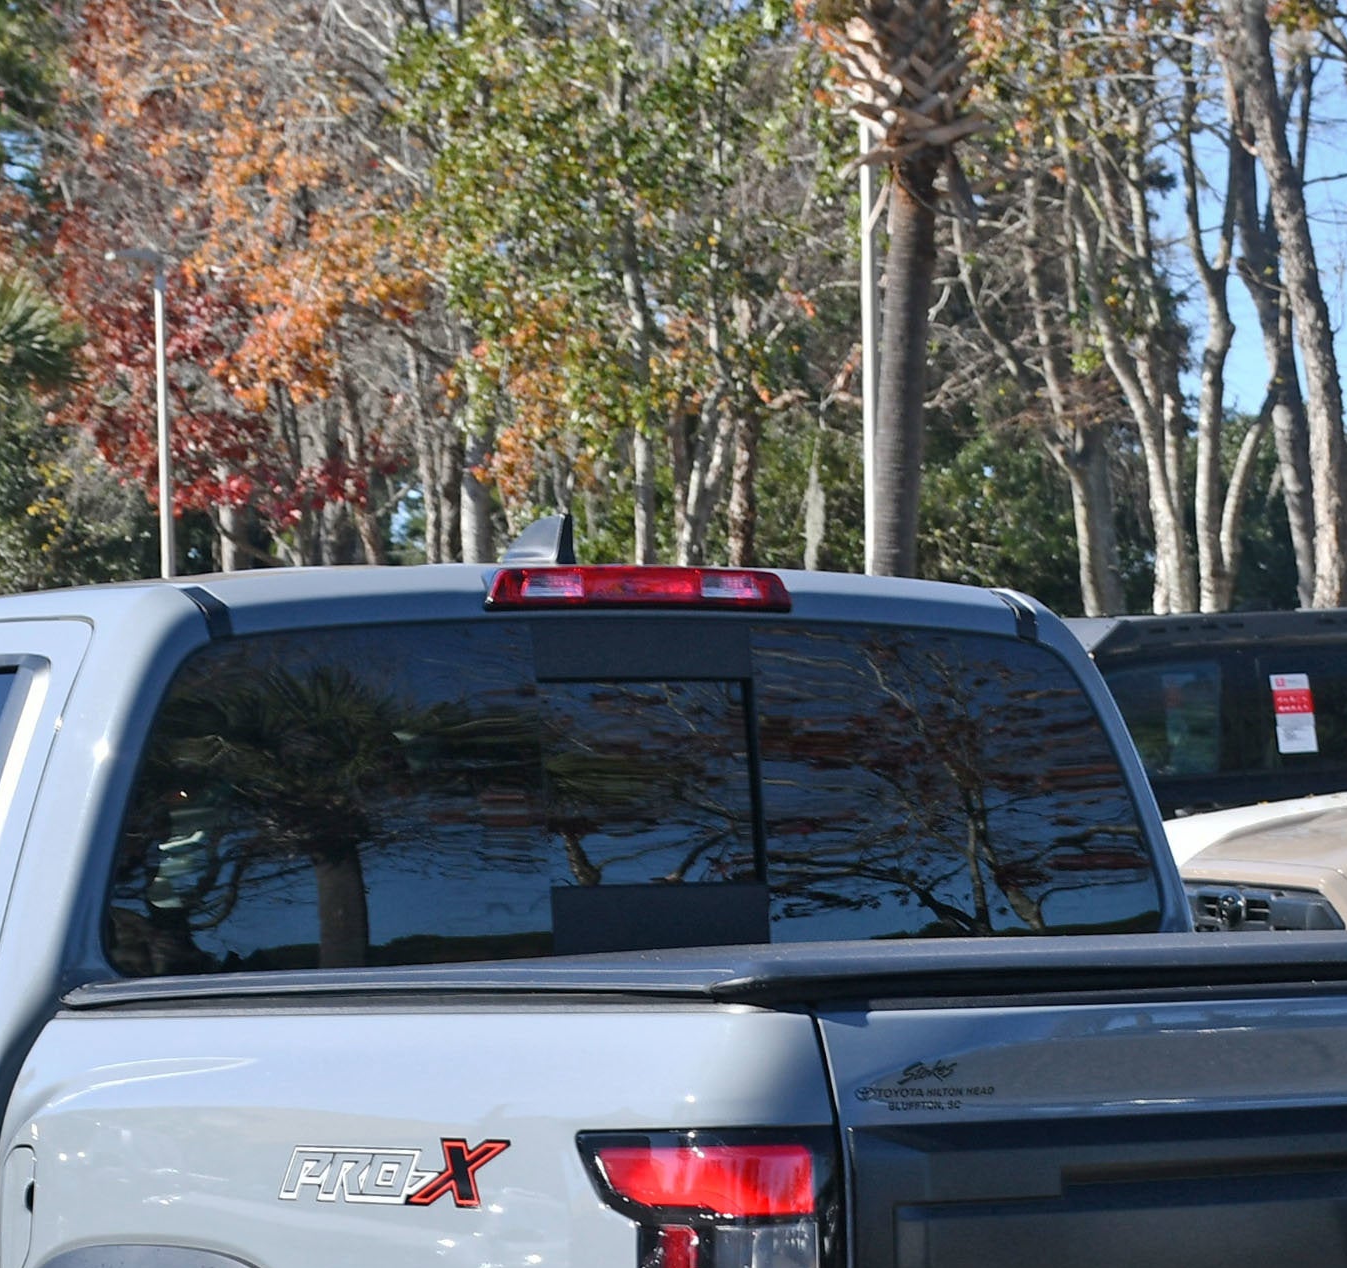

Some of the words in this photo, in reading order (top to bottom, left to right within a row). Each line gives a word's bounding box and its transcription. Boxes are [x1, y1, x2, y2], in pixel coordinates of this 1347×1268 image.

[875, 1087, 924, 1099] TOYOTA
[926, 1086, 963, 1098] HILTON
[967, 1085, 995, 1096] HEAD
[888, 1101, 945, 1112] BLUFFTON,
[948, 1100, 962, 1110] SC
